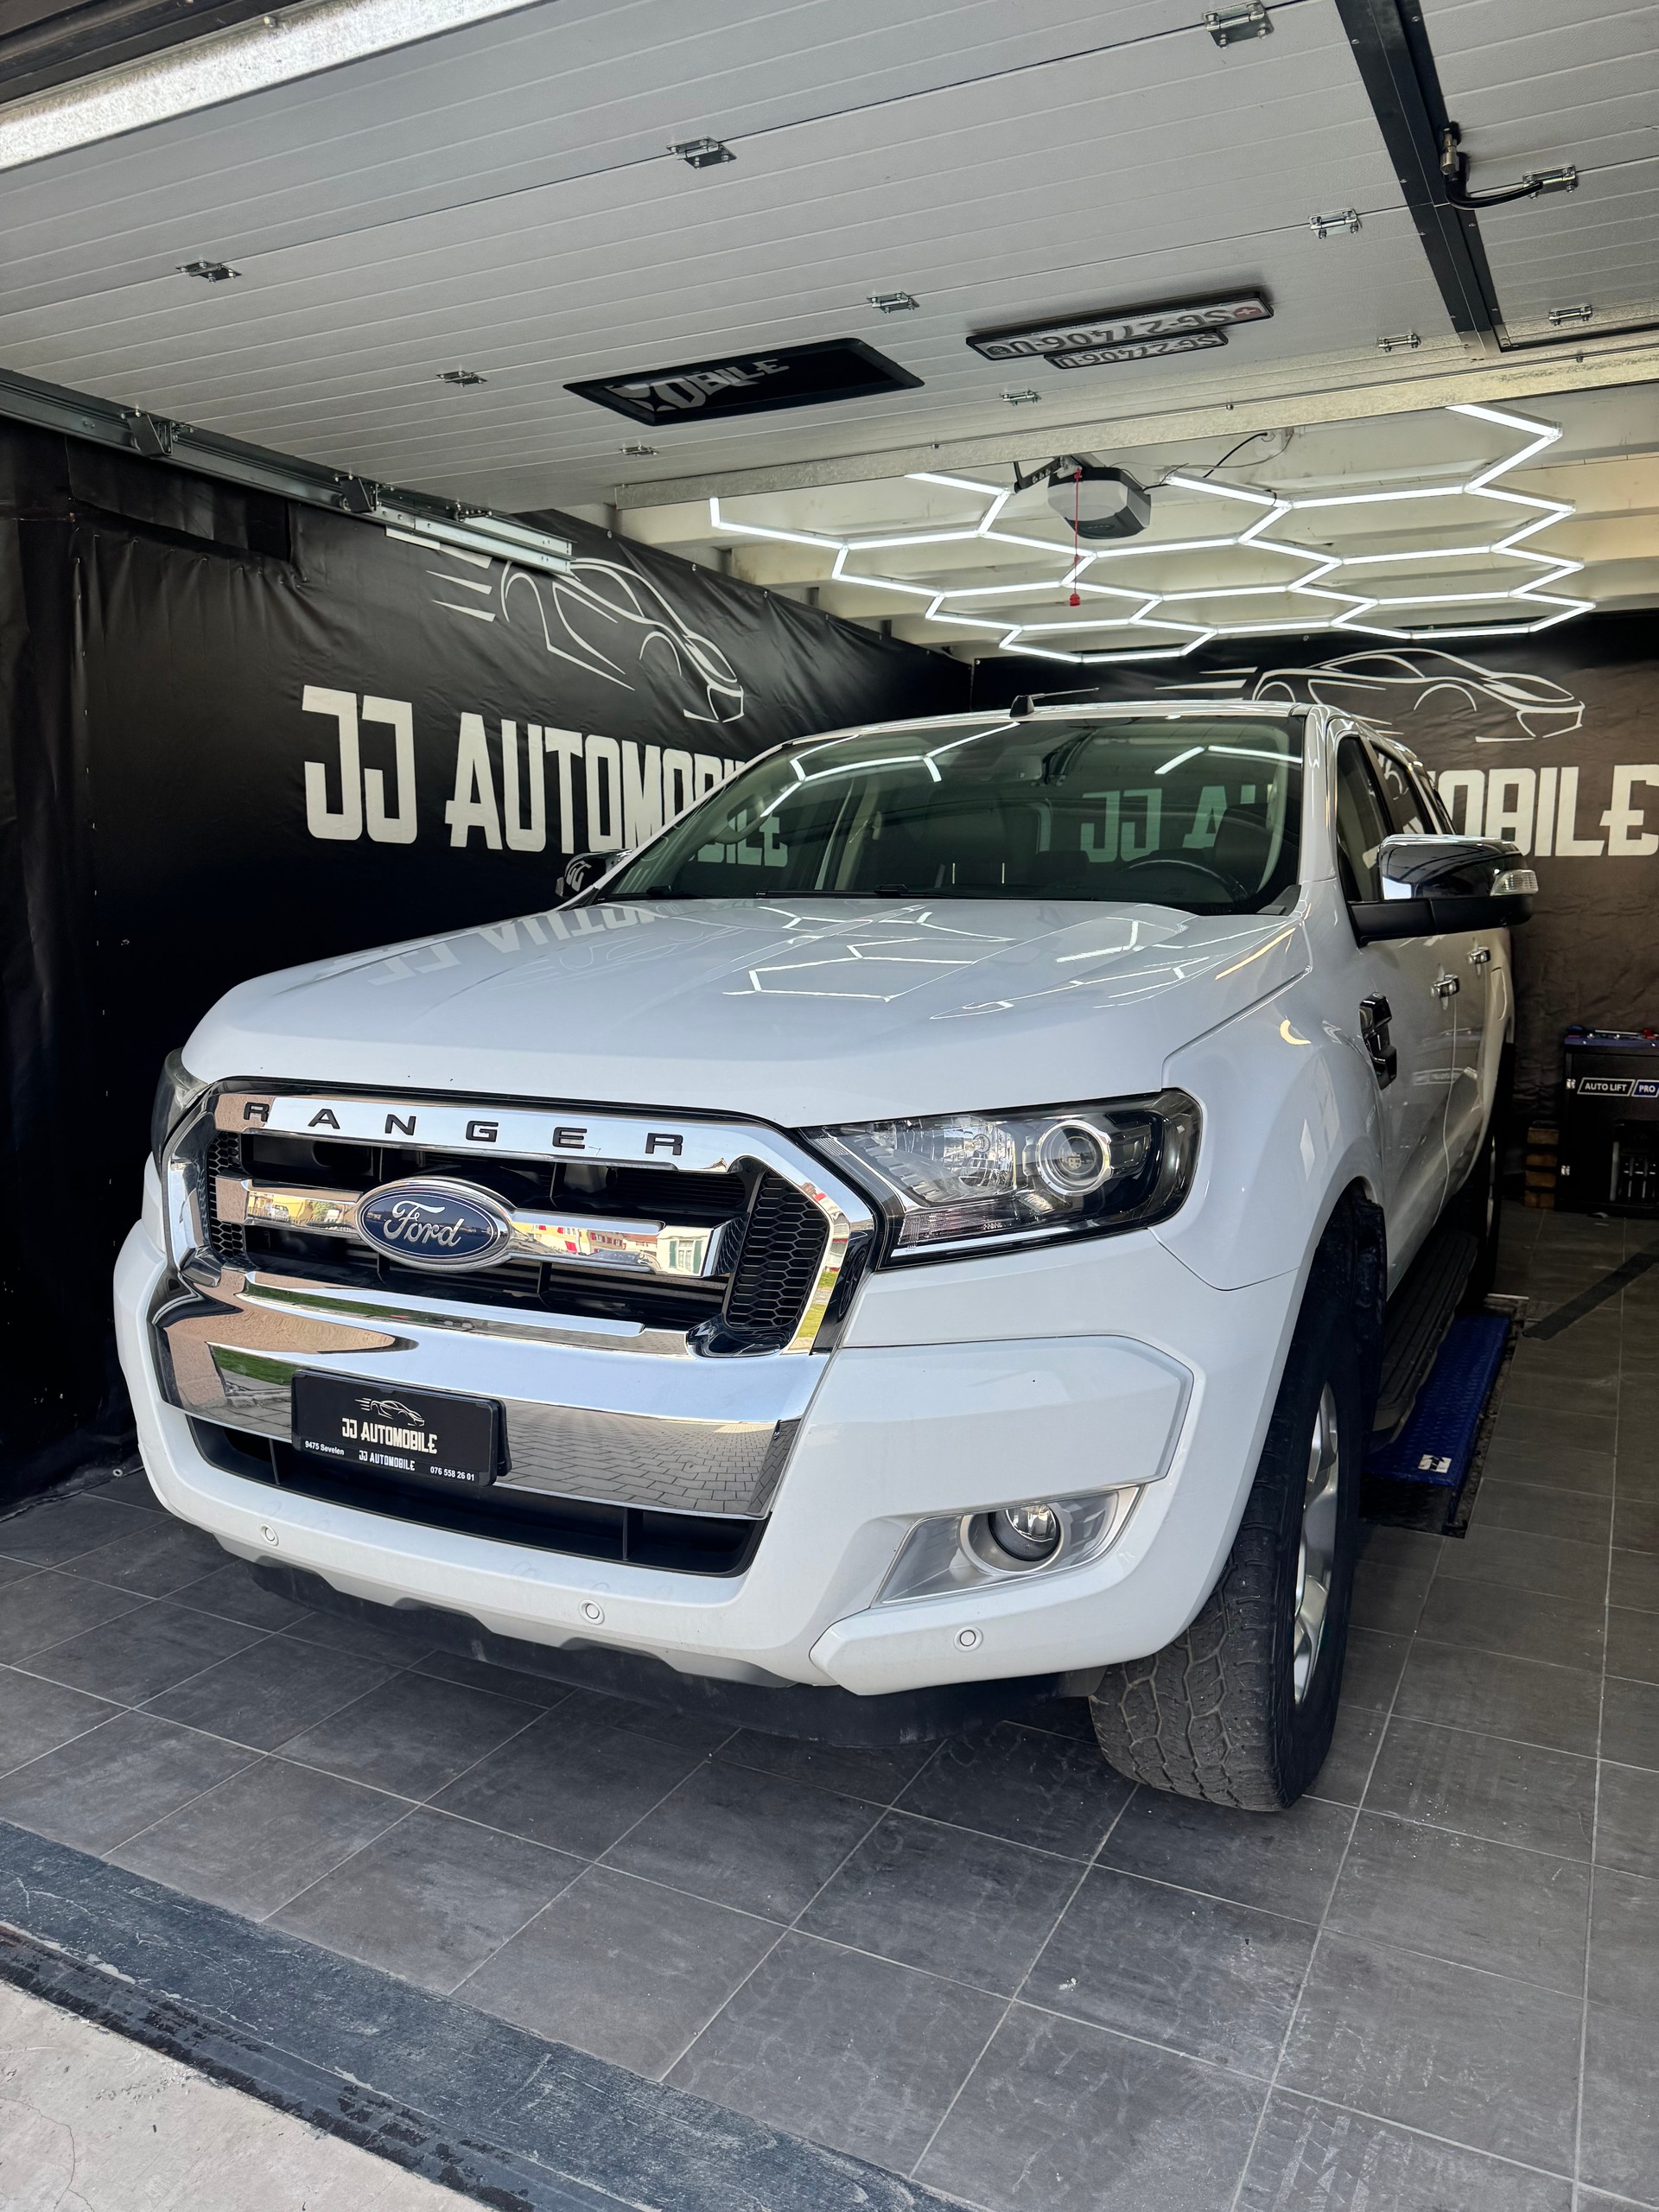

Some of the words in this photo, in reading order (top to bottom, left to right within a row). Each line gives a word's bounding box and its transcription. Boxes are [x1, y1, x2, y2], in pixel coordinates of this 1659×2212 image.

[302, 685, 418, 844] JJ
[1427, 764, 1659, 856] OBILE
[1585, 1083, 1608, 1091] AUTO
[1610, 1084, 1628, 1092] LIFT
[1639, 1084, 1656, 1093] PRO
[243, 1102, 684, 1156] RANGER
[383, 1199, 465, 1249] Ford
[305, 1440, 320, 1451] 9475
[320, 1443, 345, 1456] Sevelen
[341, 1417, 358, 1440] JJ
[360, 1421, 438, 1454] AUTOMOBILE
[359, 1450, 368, 1461] JJ
[370, 1452, 416, 1471] AUTOMOBILE
[430, 1466, 442, 1476] 076
[443, 1468, 455, 1478] 558
[456, 1471, 466, 1479] 26
[467, 1472, 474, 1481] 01
